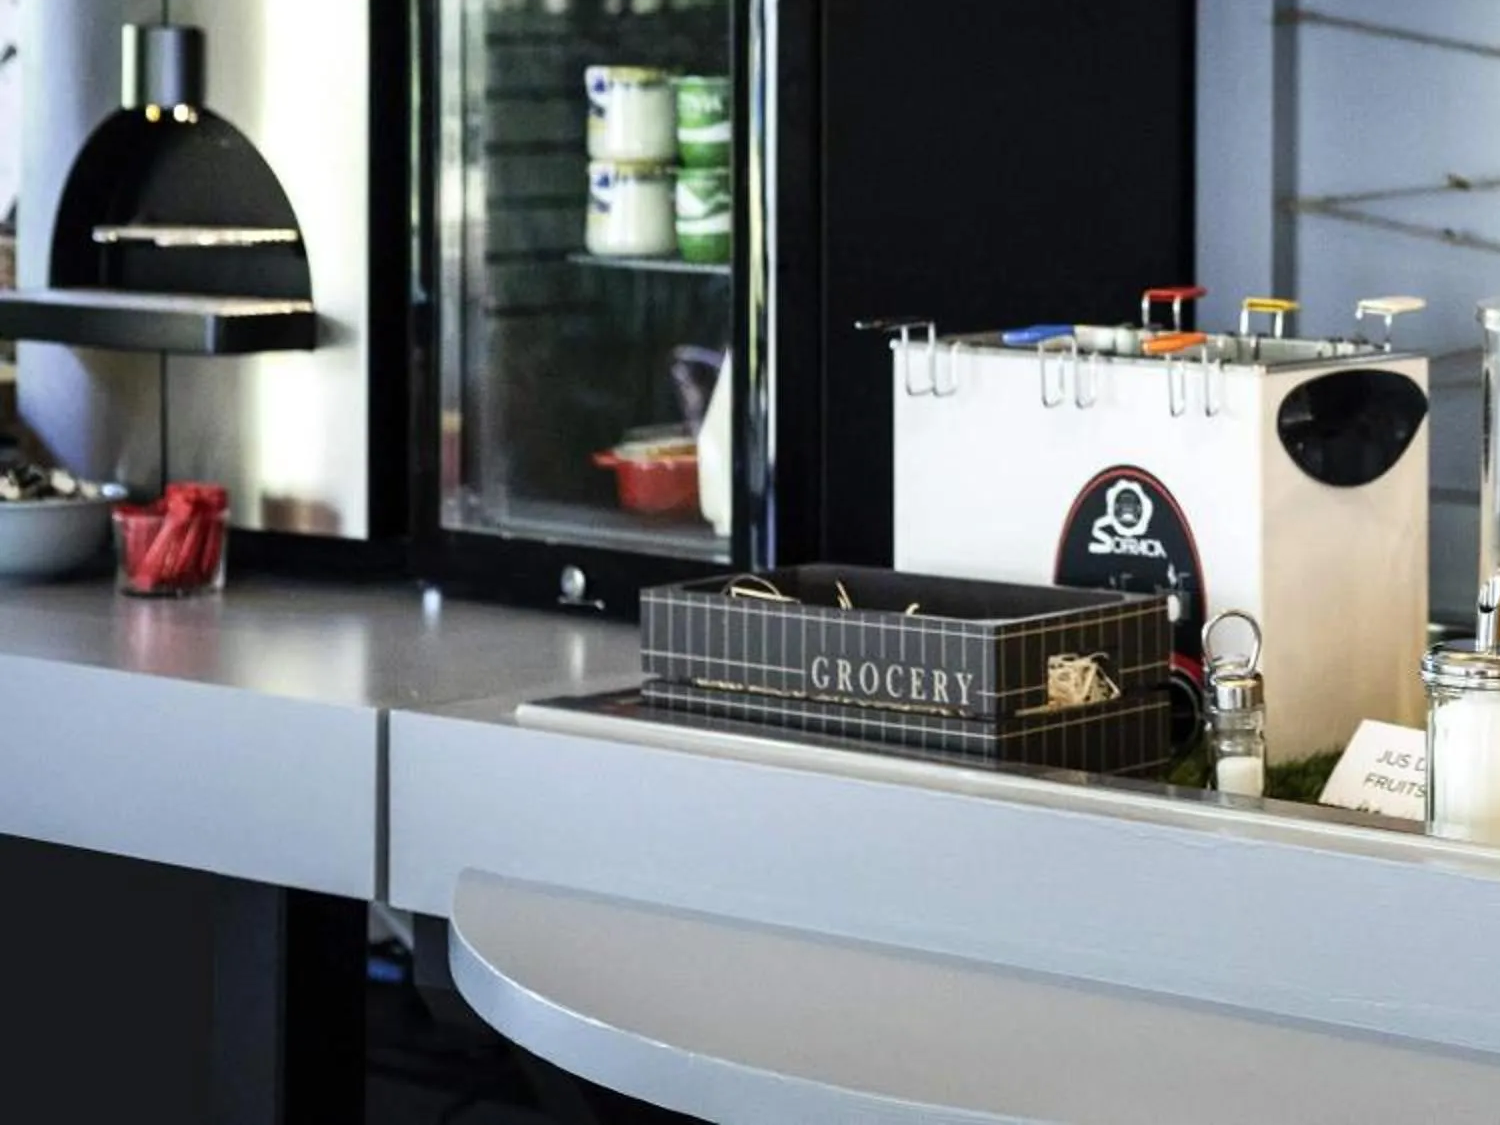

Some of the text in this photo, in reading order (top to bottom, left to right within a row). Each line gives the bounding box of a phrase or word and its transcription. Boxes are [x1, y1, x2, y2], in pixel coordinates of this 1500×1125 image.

[811, 655, 973, 705] GROCERY
[1376, 749, 1411, 768] JUS
[1364, 772, 1427, 797] FRUITS
